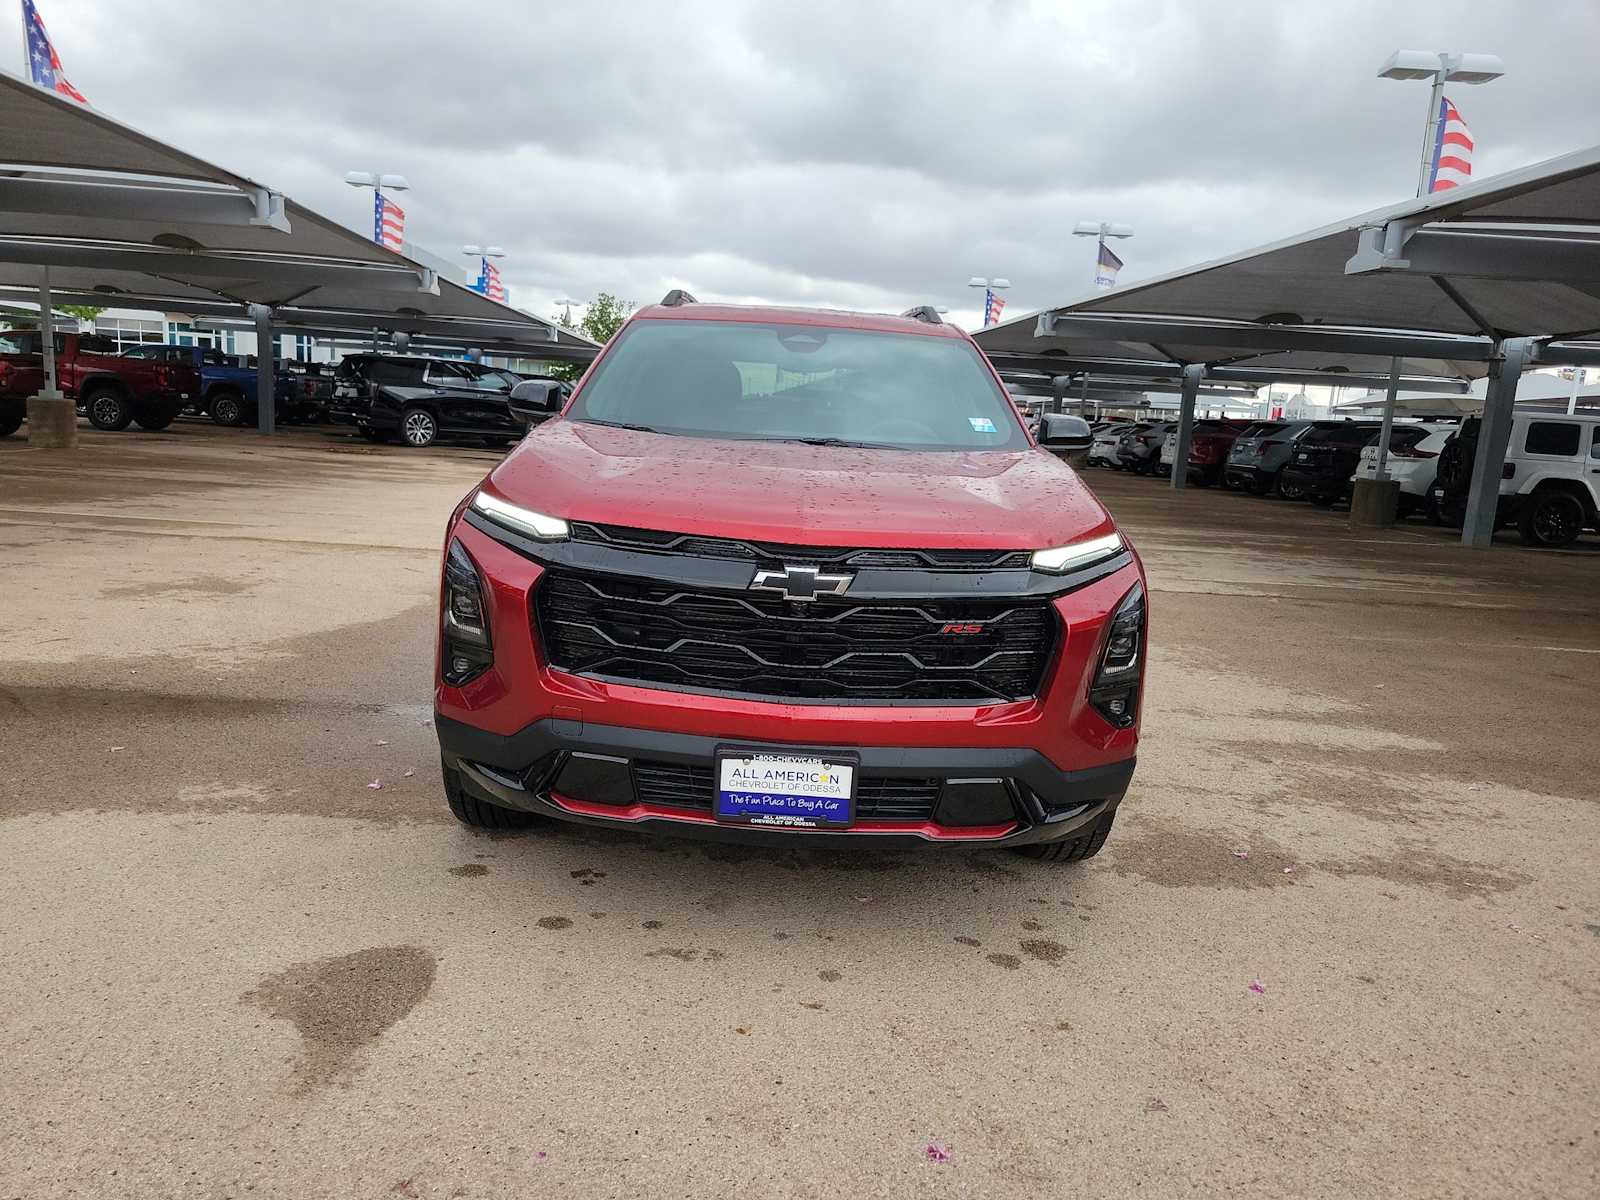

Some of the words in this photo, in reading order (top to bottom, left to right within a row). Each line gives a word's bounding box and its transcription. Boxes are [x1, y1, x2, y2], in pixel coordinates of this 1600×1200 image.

[943, 624, 982, 633] RS
[732, 768, 759, 778] ALL
[764, 770, 840, 784] AMERICN
[729, 779, 785, 790] CHEVROLET
[803, 784, 841, 793] ODESSA
[729, 794, 744, 804] The
[745, 796, 761, 804] Fun
[762, 797, 784, 806] Place
[786, 798, 796, 806] To
[798, 799, 814, 810] Buy
[815, 800, 823, 809] A
[825, 800, 839, 810] Car
